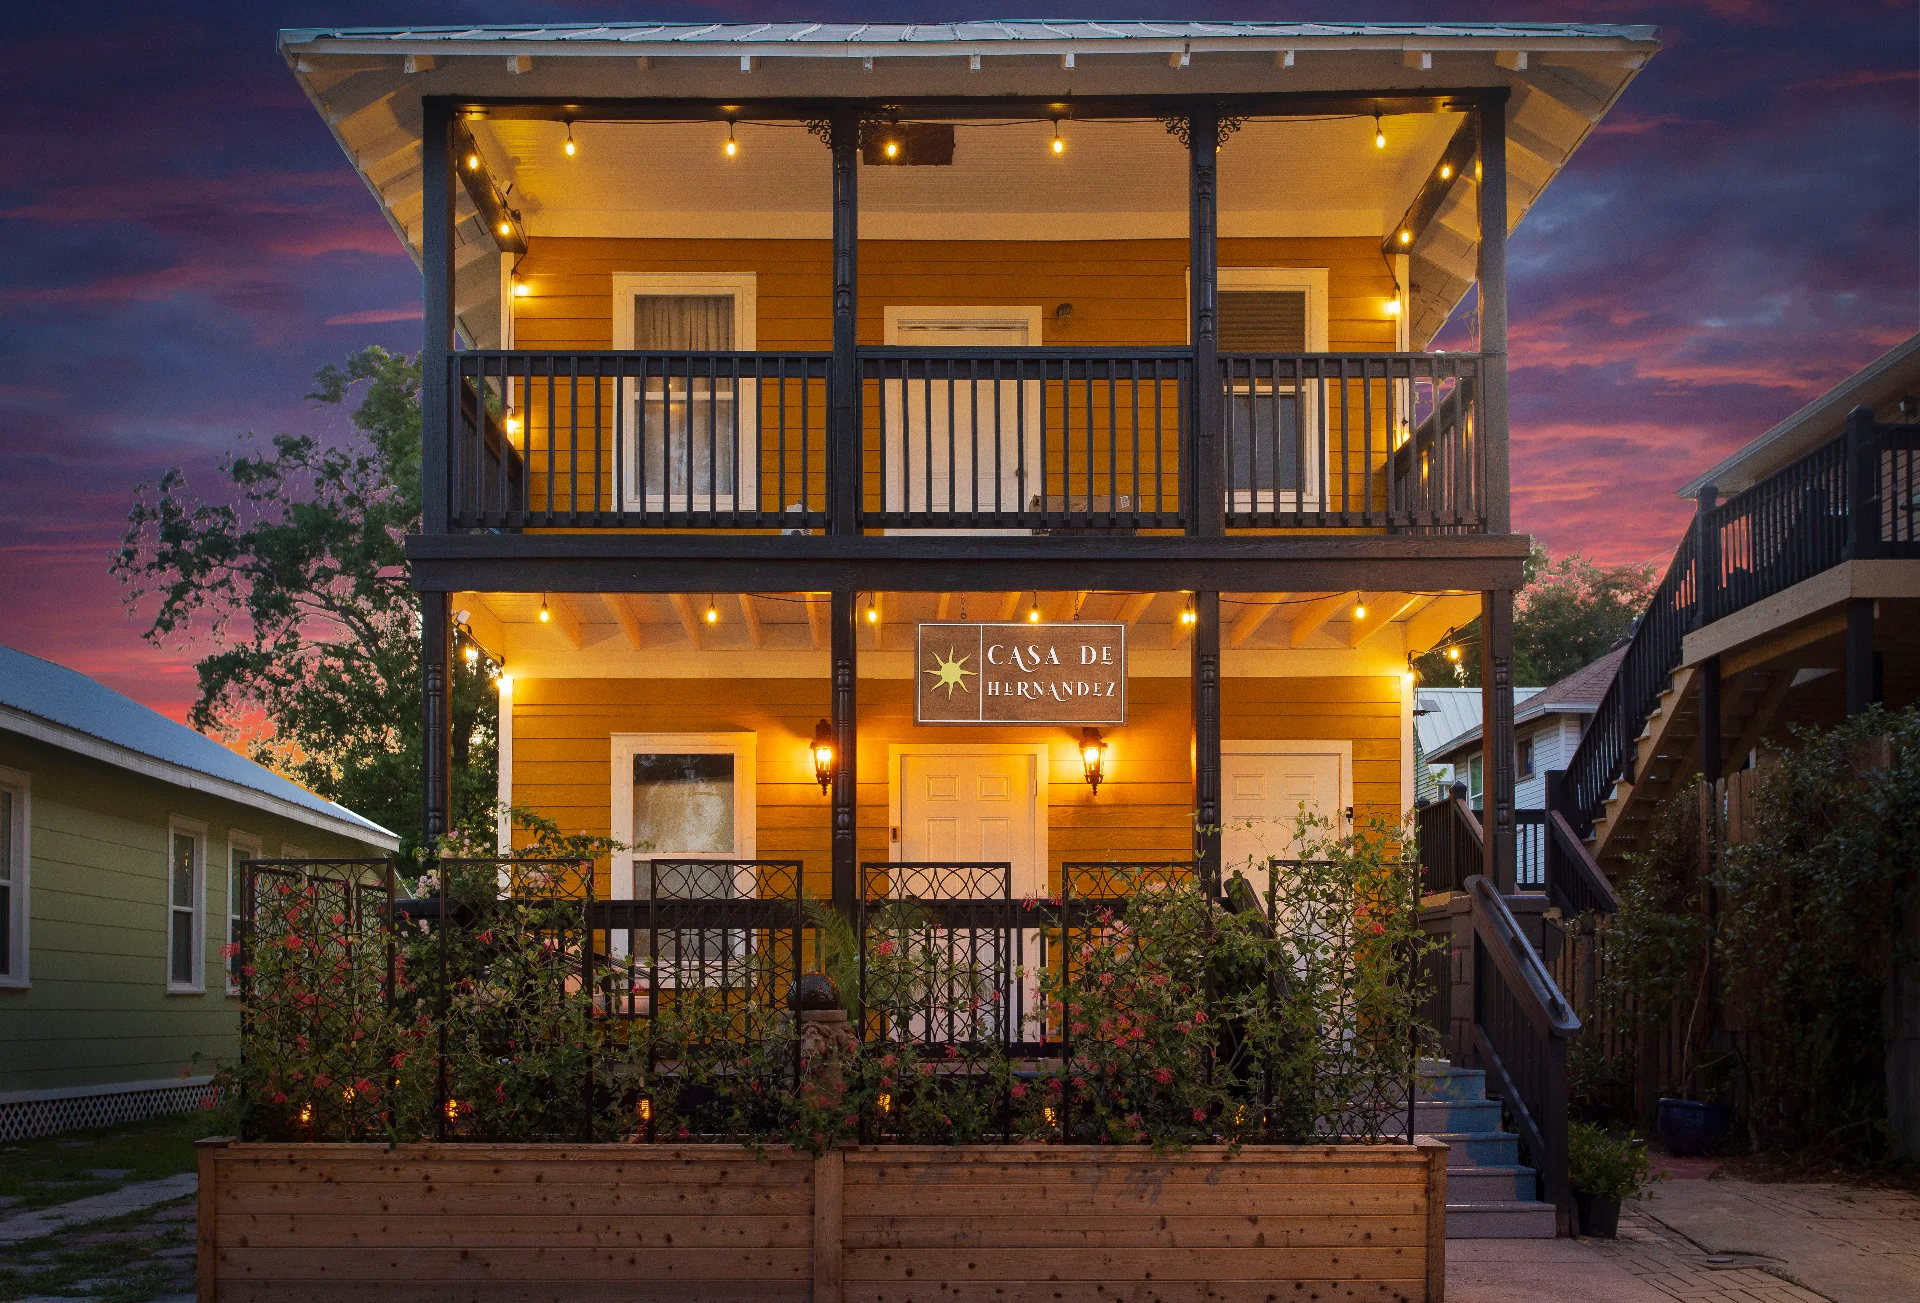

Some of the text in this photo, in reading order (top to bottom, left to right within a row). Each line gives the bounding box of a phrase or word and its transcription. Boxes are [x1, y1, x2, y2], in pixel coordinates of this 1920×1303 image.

[987, 644, 1114, 672] CASA DE
[987, 681, 1115, 702] HERNANDEZ
